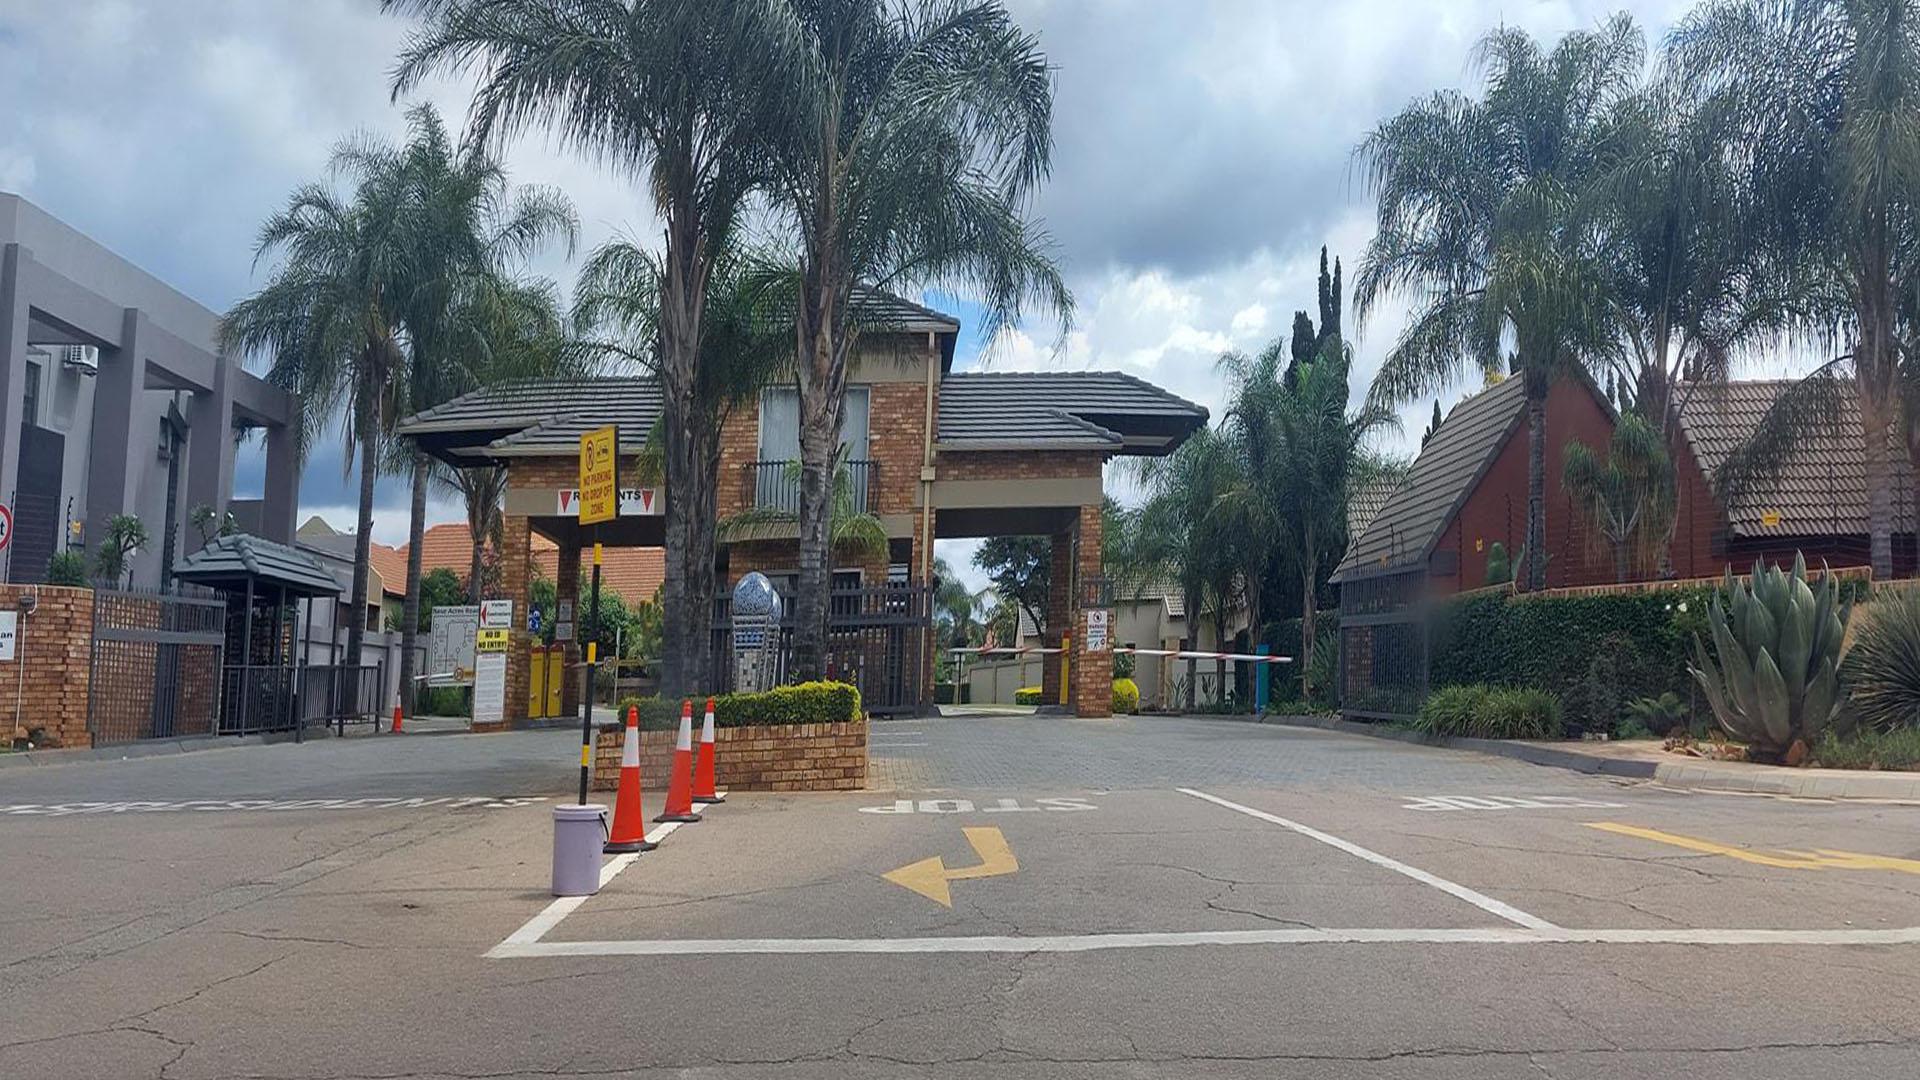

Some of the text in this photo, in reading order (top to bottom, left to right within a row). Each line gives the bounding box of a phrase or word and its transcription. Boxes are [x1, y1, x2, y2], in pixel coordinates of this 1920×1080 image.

[591, 469, 612, 483] PARKING
[590, 486, 602, 500] DROP
[603, 484, 613, 497] OFF
[591, 502, 604, 515] ZONE
[485, 631, 494, 639] NO
[478, 641, 486, 649] NO
[858, 798, 1099, 814] STOP
